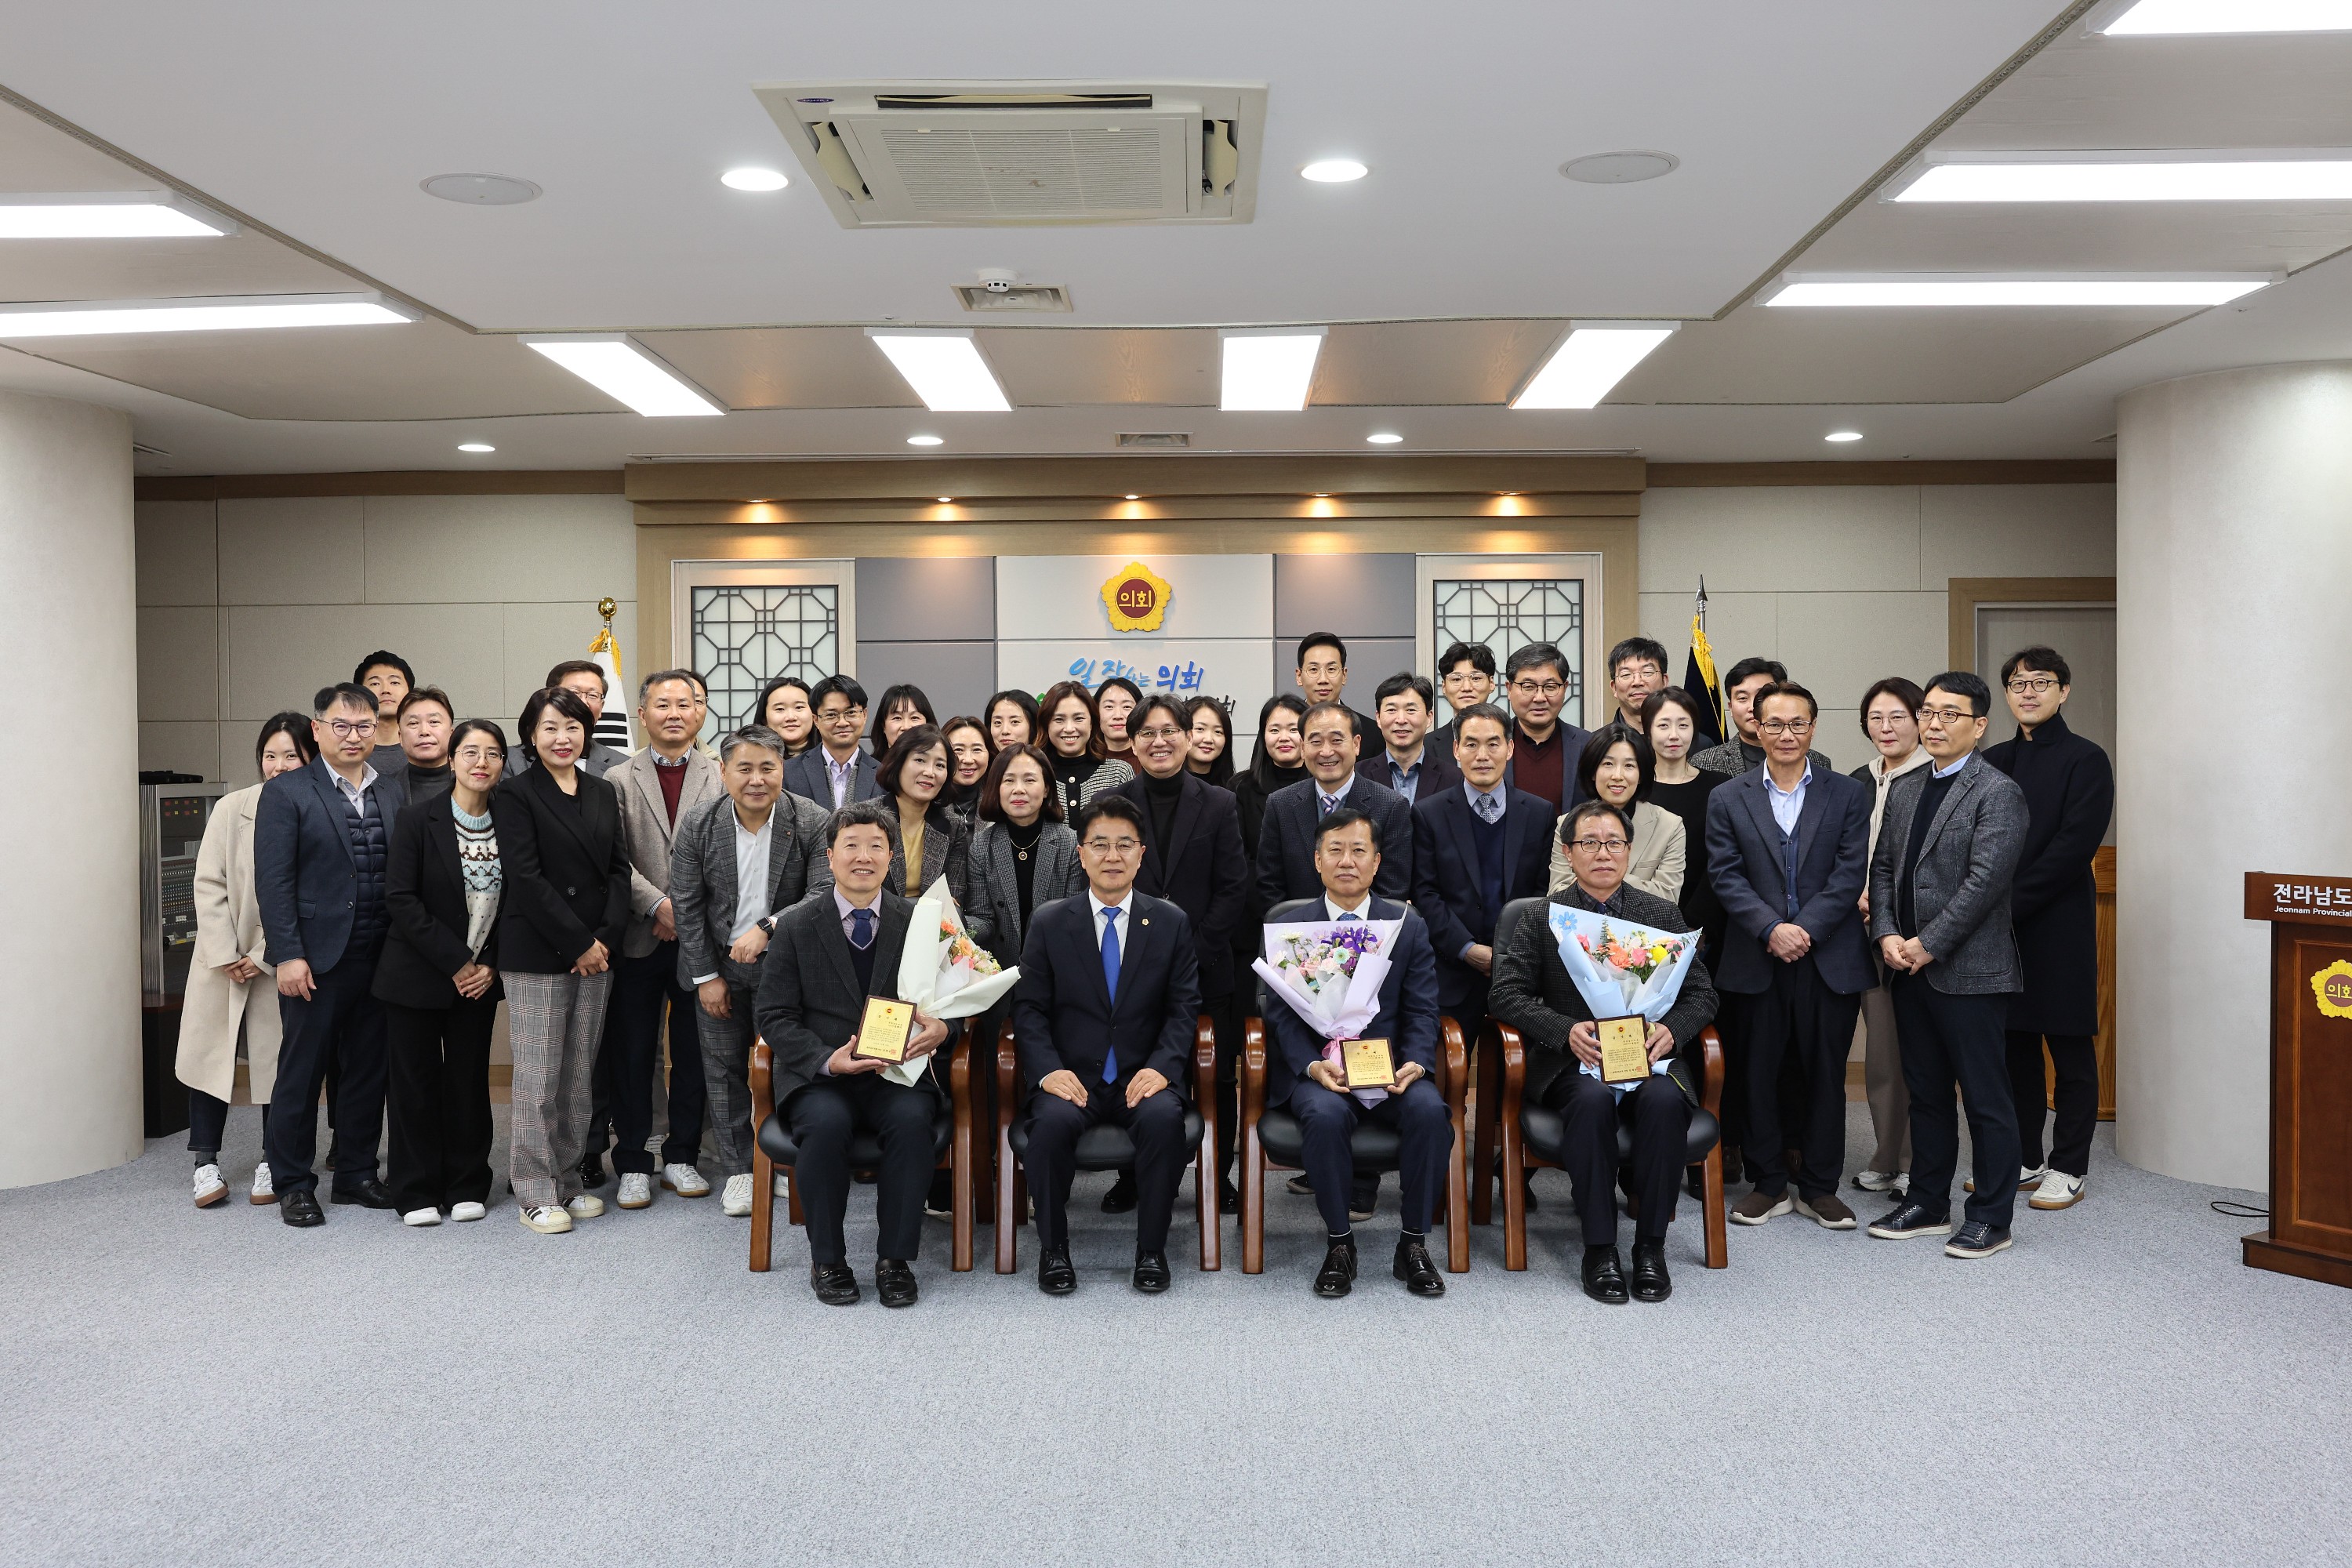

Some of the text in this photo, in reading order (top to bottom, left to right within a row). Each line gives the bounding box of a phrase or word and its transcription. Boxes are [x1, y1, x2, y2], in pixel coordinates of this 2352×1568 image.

[1118, 590, 1152, 608] 의회
[1156, 660, 1205, 692] 의회
[2273, 884, 2352, 906] 전라남도
[2274, 905, 2352, 917] Jeonnam Provincial
